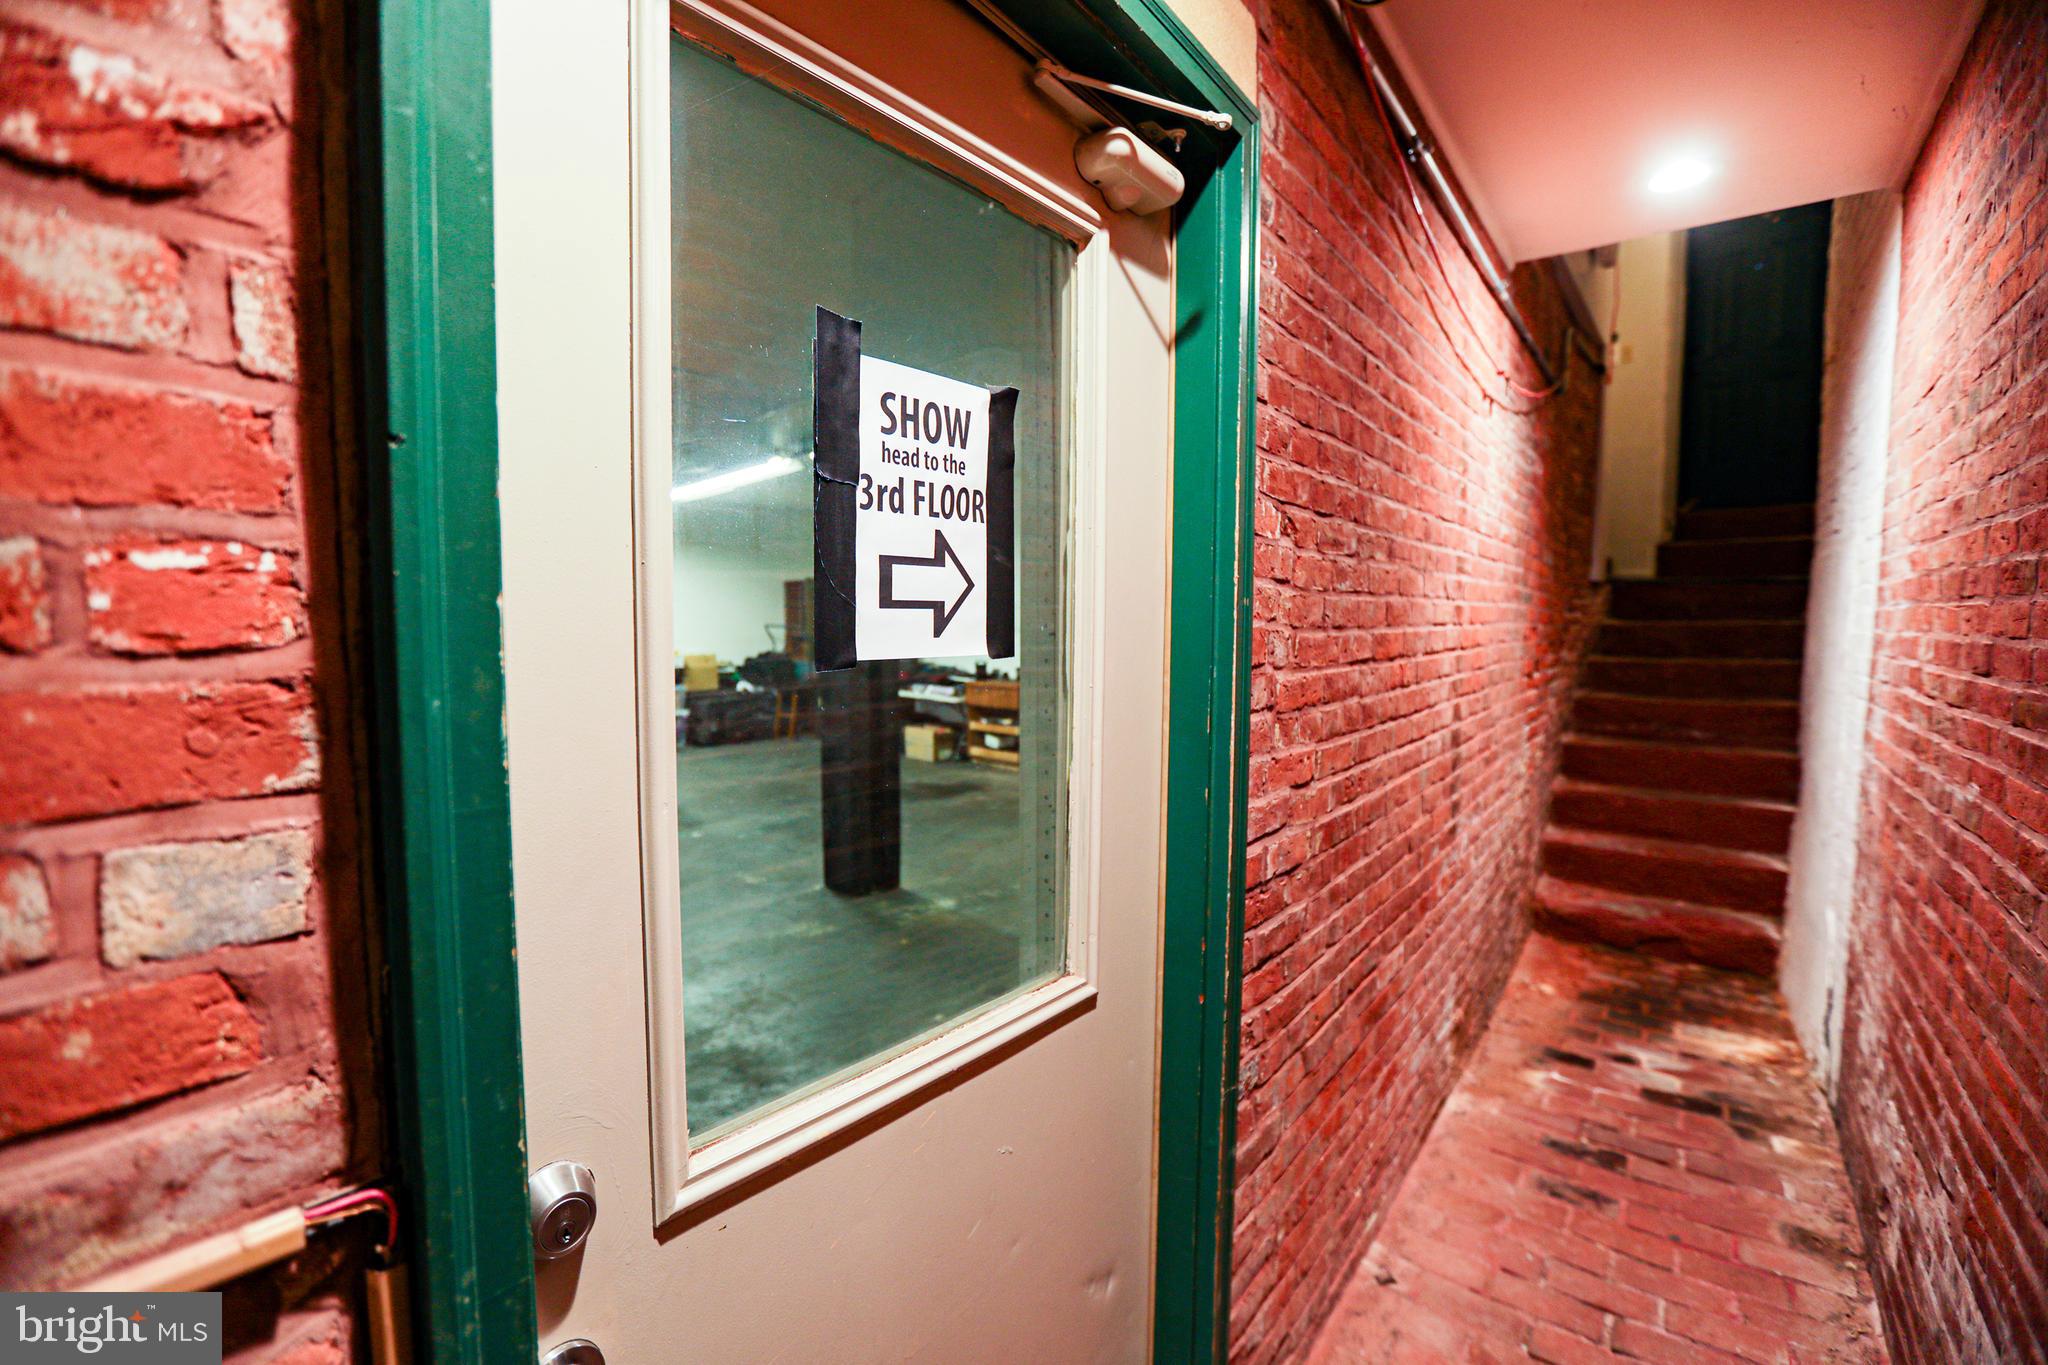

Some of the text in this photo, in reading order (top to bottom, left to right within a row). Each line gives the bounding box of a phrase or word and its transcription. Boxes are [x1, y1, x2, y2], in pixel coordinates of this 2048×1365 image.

[880, 392, 972, 450] SHOW
[881, 441, 966, 476] head to the
[859, 473, 985, 524] 3rd FLOOR
